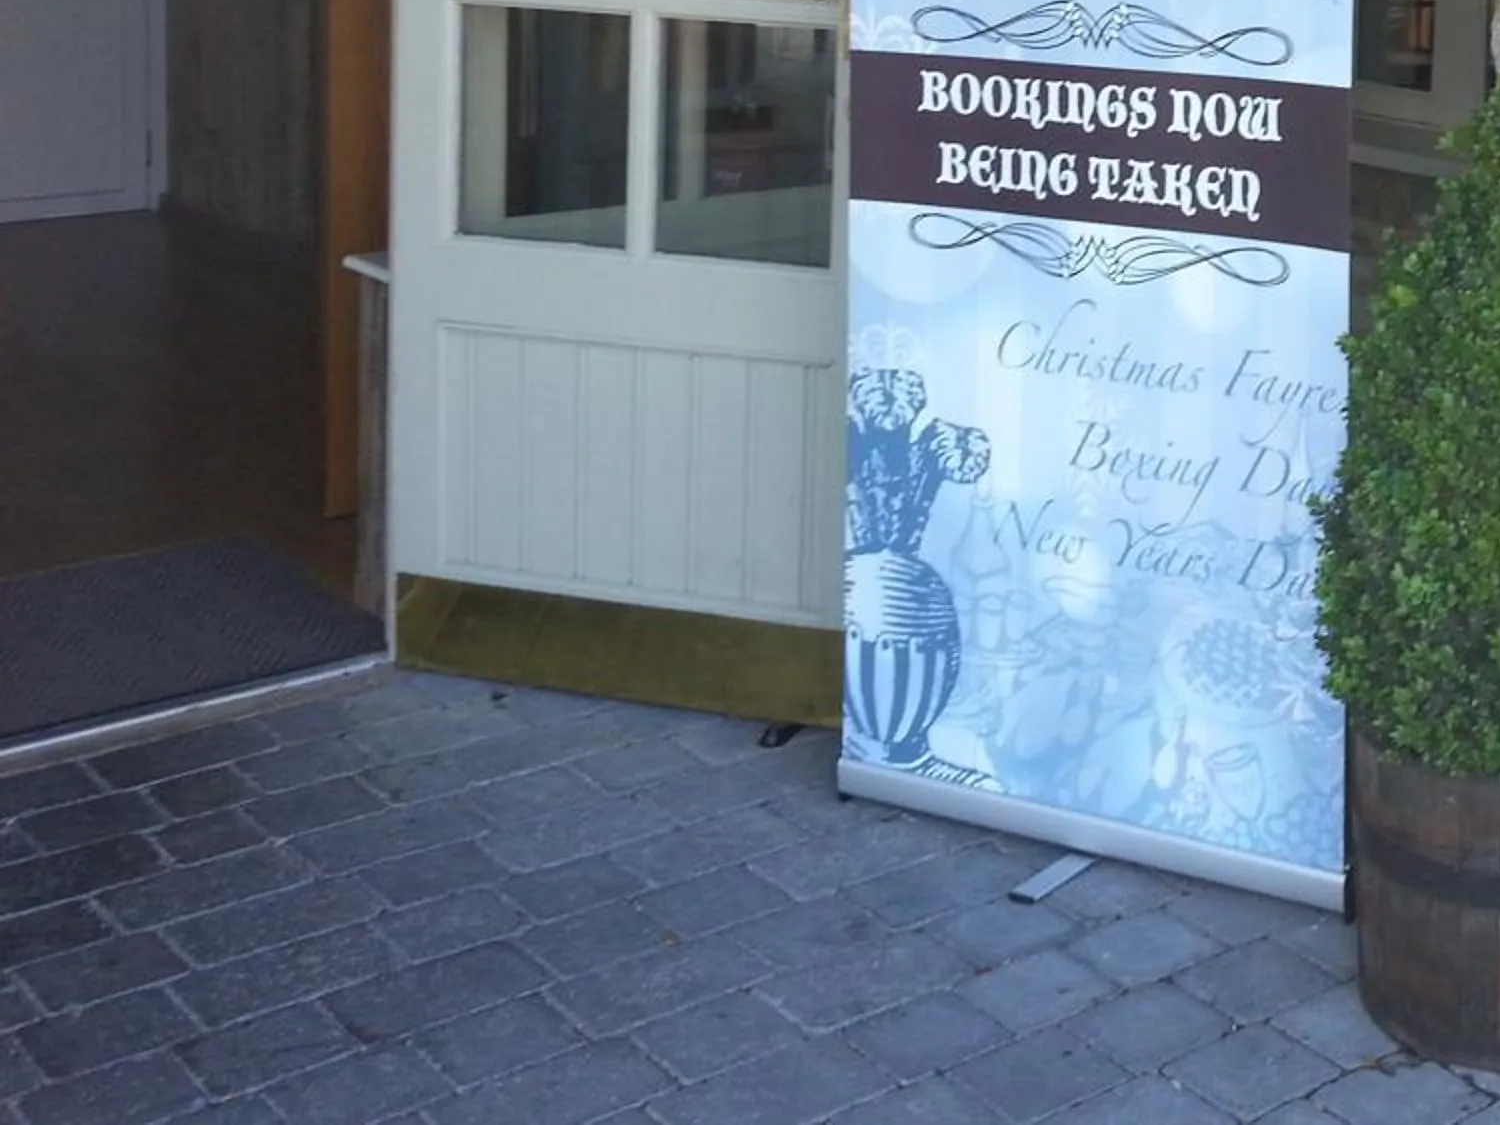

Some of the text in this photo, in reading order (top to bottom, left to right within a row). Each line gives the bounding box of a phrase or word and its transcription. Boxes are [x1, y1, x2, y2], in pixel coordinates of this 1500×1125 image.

[918, 70, 1282, 142] BOOKINGS NOW
[936, 141, 1262, 222] BEING TAKEN
[998, 299, 1343, 446] Christmas Fayre
[1069, 420, 1219, 537] Boxing
[994, 499, 1315, 601] New Years Da
